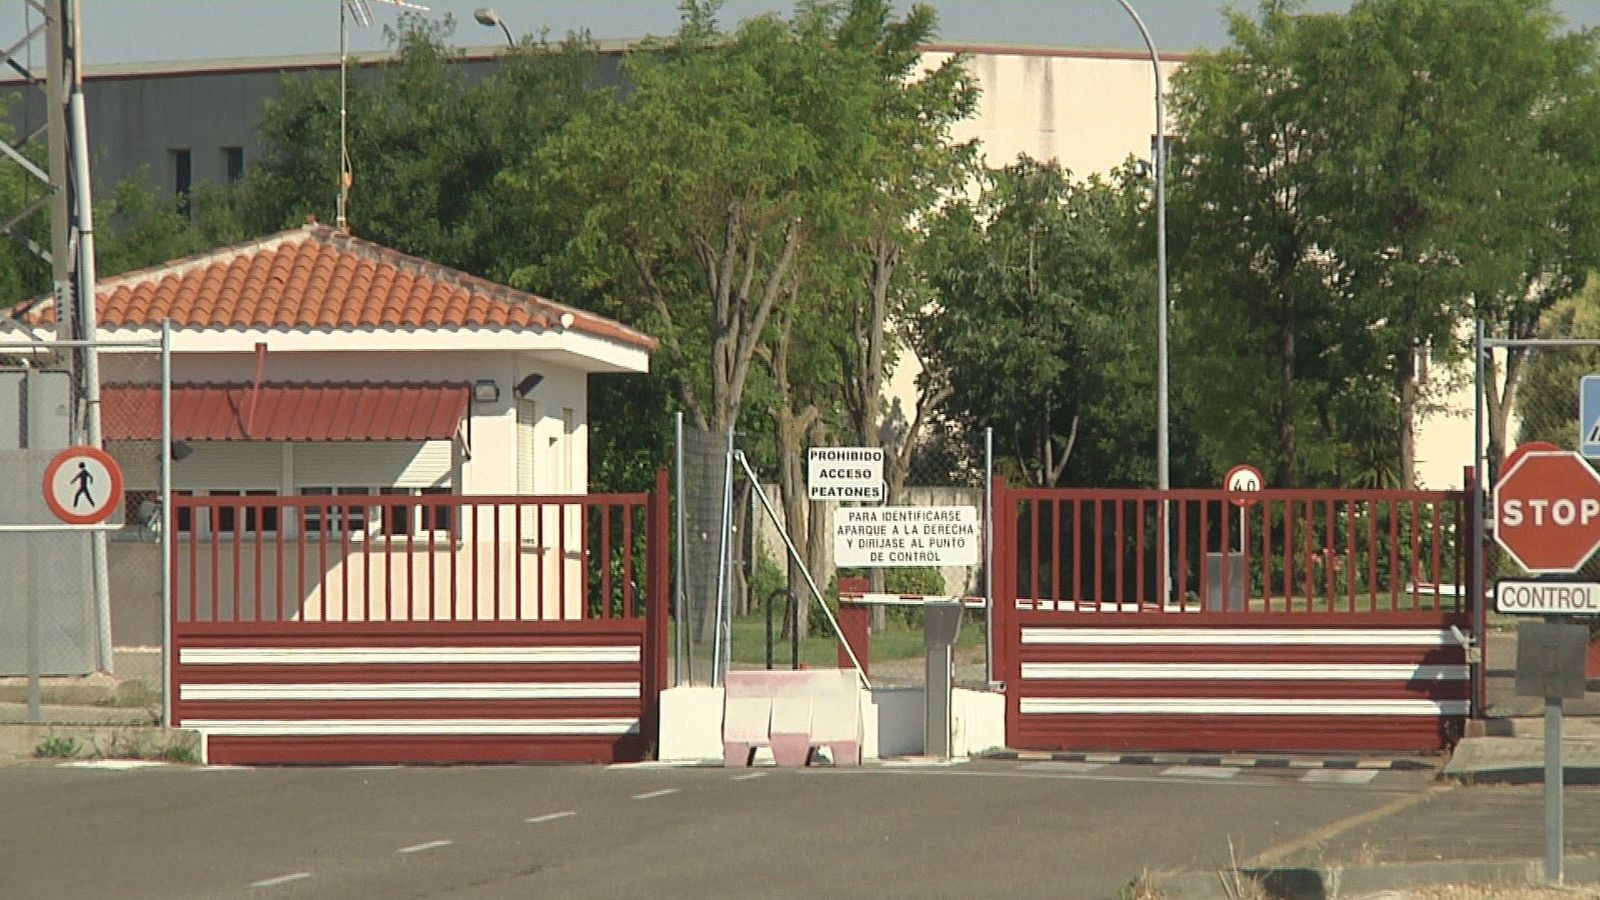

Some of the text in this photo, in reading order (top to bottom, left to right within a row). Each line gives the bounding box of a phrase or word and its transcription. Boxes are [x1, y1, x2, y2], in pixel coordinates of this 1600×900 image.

[810, 450, 882, 462] PROHIBIDO
[819, 468, 872, 480] ACCESO
[1234, 479, 1256, 491] 40
[811, 486, 880, 498] PEATONES
[849, 510, 961, 522] PARA IDENTIFICARSE
[1502, 499, 1600, 526] STOP
[837, 524, 974, 536] APARQUE A LA DERECHA
[846, 538, 965, 549] Y DIRIJASE AL PUNTO
[870, 551, 941, 562] DE CONTROL
[1501, 586, 1597, 609] CONTROL
